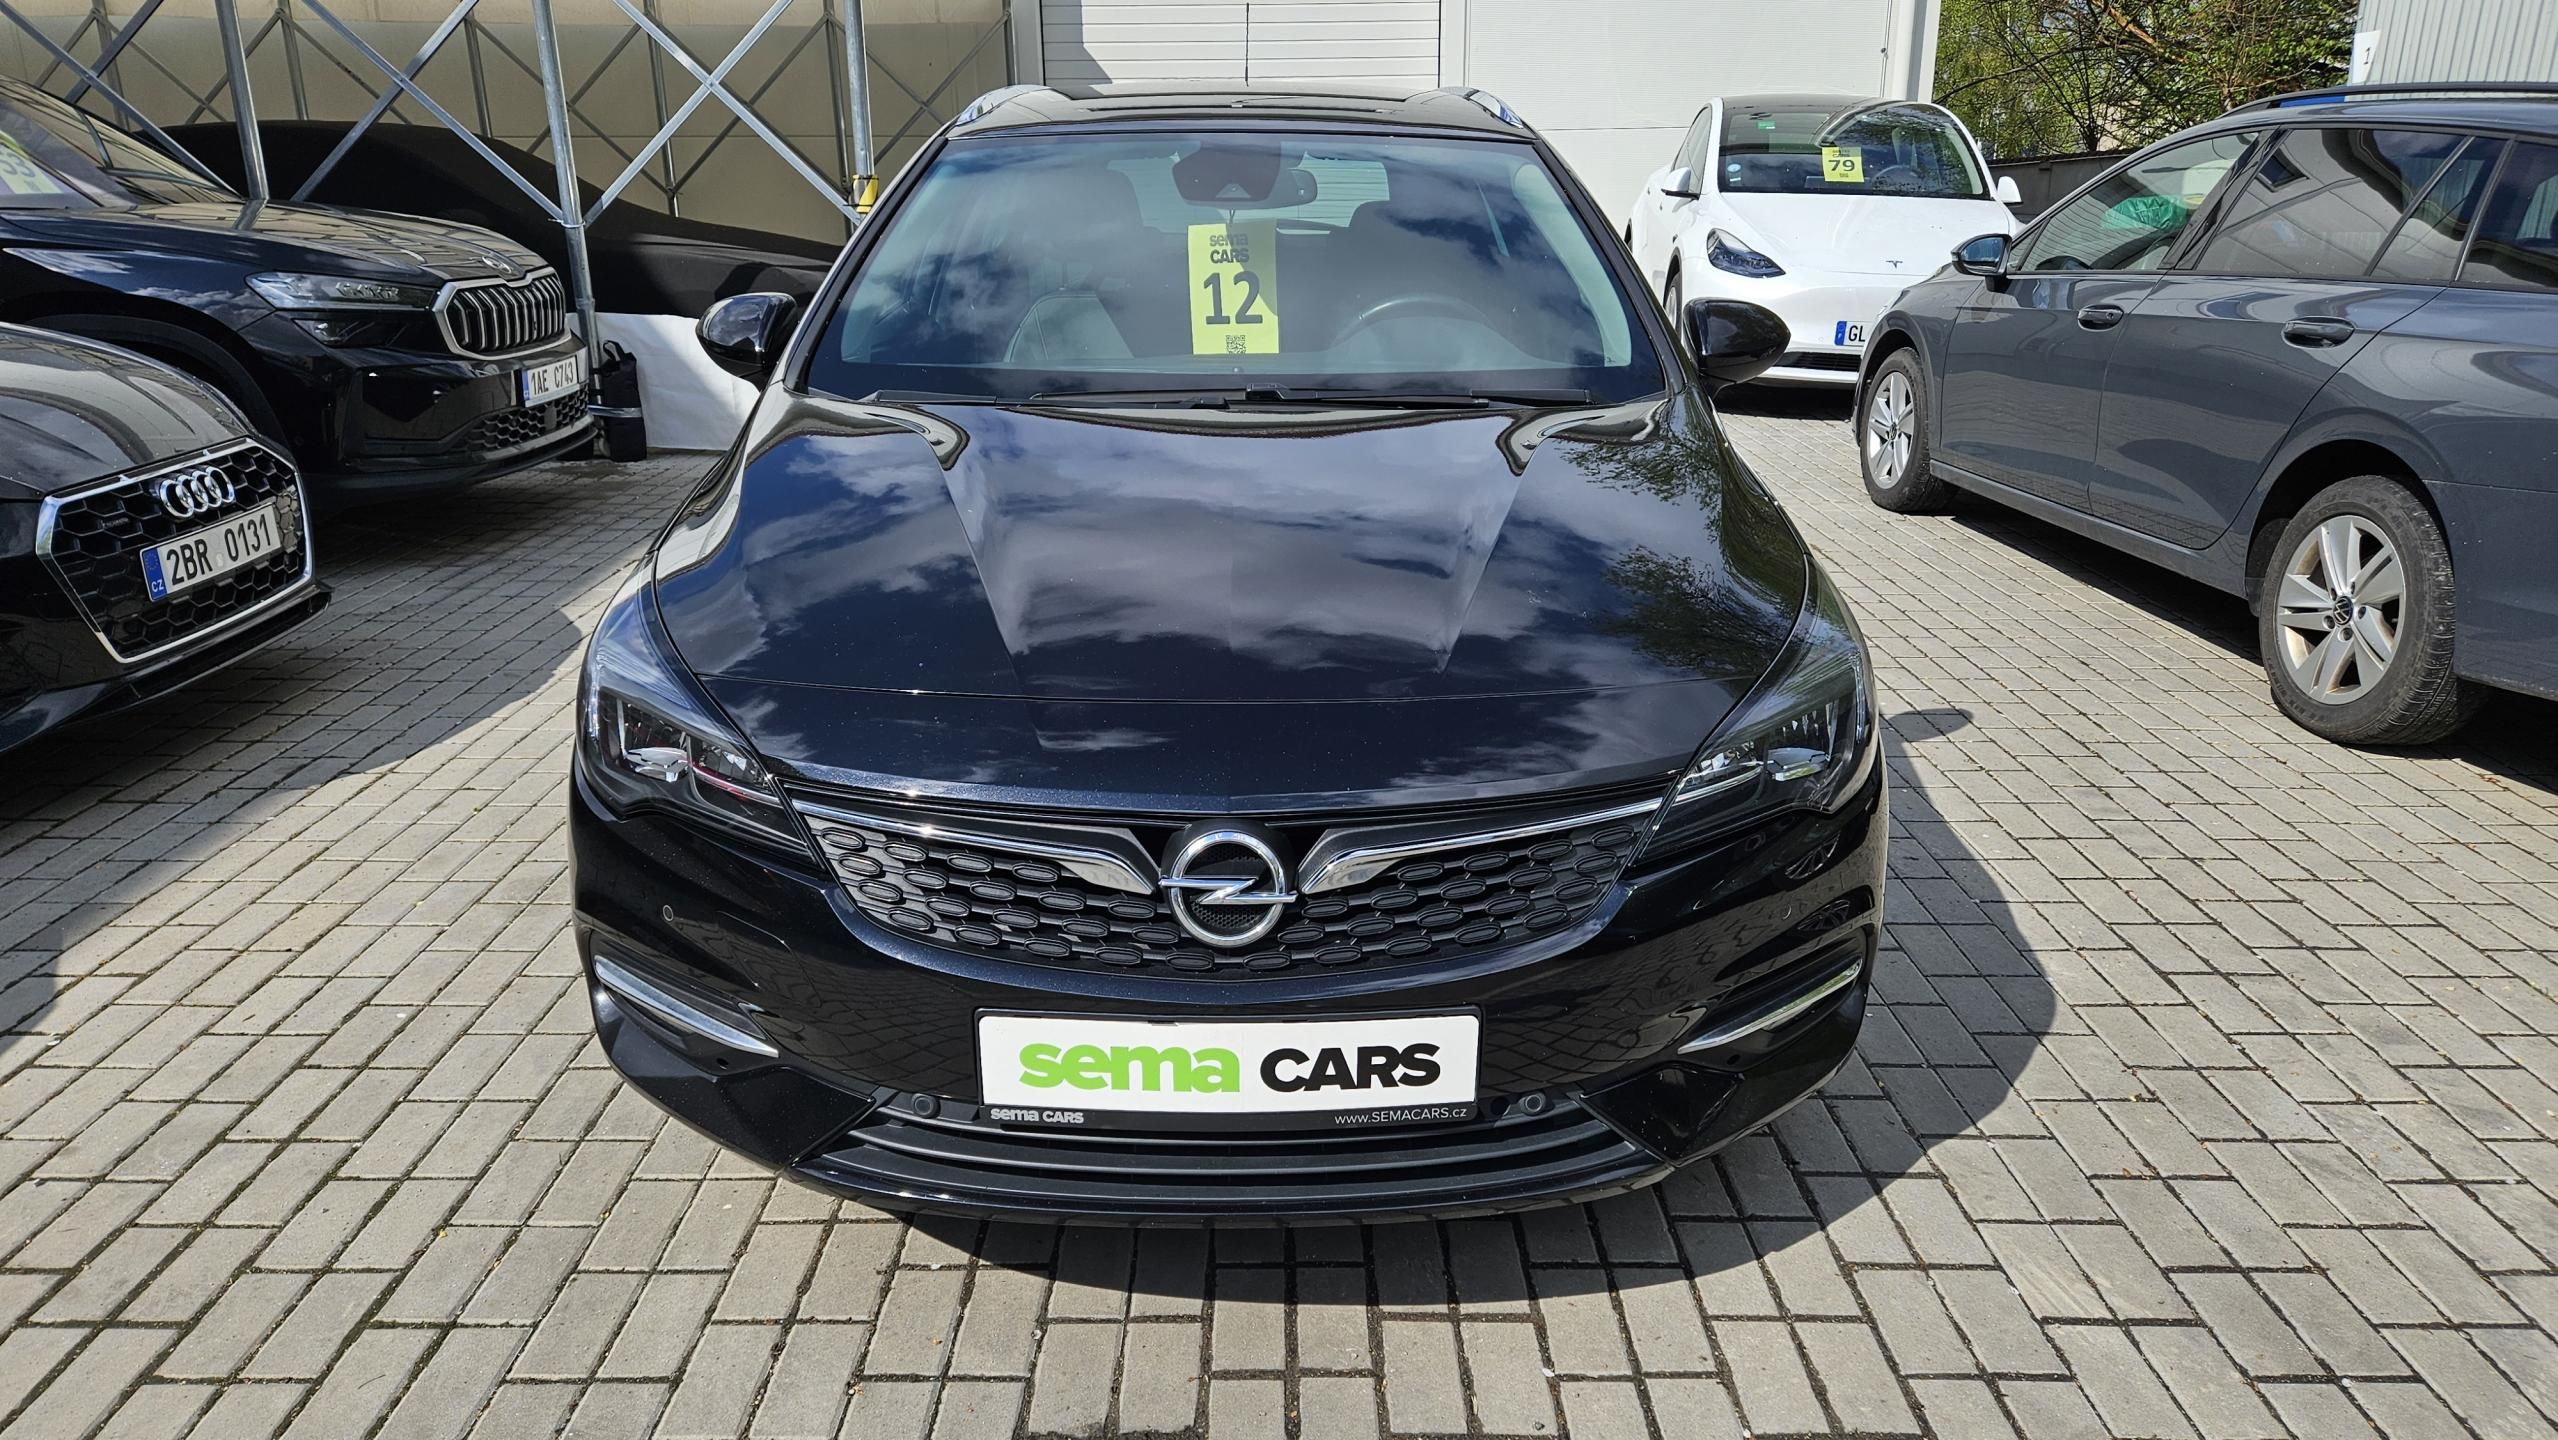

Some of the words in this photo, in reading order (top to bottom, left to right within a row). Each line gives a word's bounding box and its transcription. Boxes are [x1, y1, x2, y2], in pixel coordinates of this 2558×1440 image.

[1828, 159, 1855, 172] 79
[1209, 234, 1249, 247] sema
[1210, 248, 1250, 264] CARS
[1203, 270, 1263, 325] 12
[1848, 324, 1866, 342] GL
[531, 369, 548, 395] 1AE
[554, 361, 573, 388] C743
[166, 539, 212, 585] 2BR
[223, 513, 271, 562] 0131
[151, 579, 165, 593] CZ
[1018, 1042, 1240, 1094] sema
[1259, 1042, 1441, 1093] CARS
[990, 1107, 1040, 1122] sema
[1042, 1110, 1085, 1124] CARS
[1334, 1107, 1468, 1125] www.SEMACARS.cz
